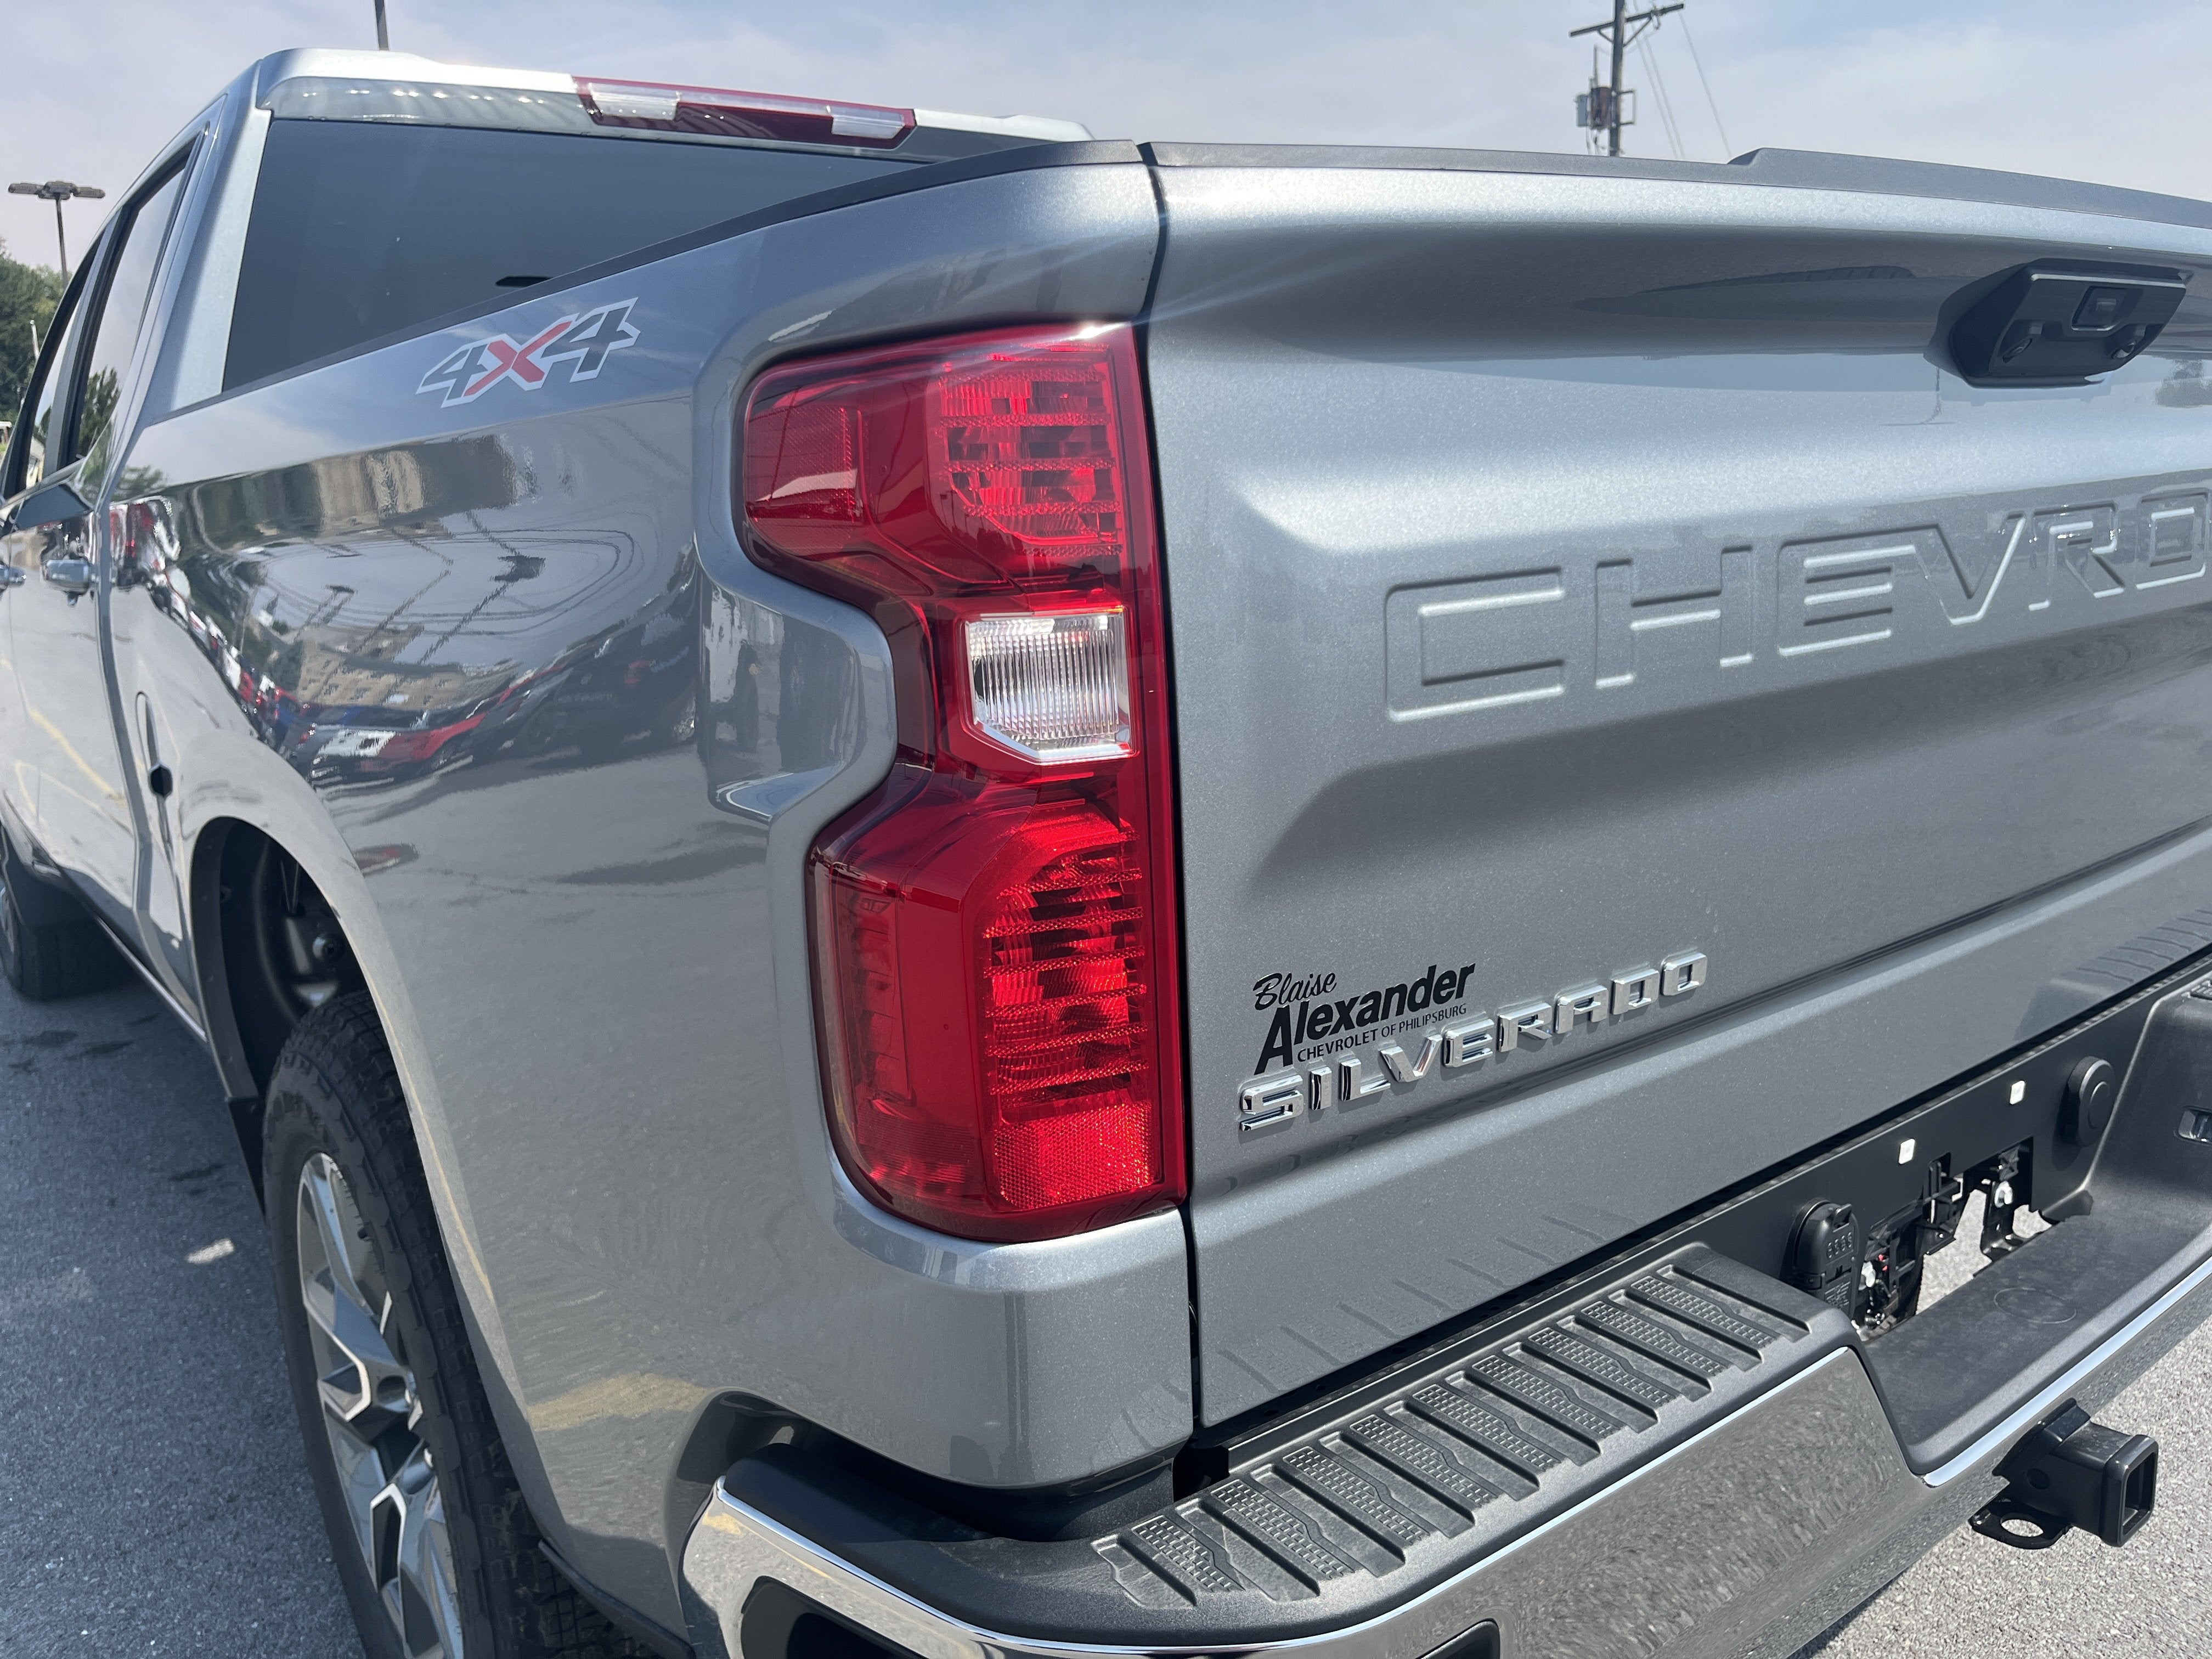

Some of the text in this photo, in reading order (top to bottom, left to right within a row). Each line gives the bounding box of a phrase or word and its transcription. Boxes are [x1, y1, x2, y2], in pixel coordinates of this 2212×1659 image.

[1252, 972, 1337, 1011] Blaise
[1254, 963, 1476, 1075] Alexander
[1297, 1003, 1466, 1062] CHEVROLET OF PHILIPSBURG
[1239, 951, 1708, 1132] SILVERADO
